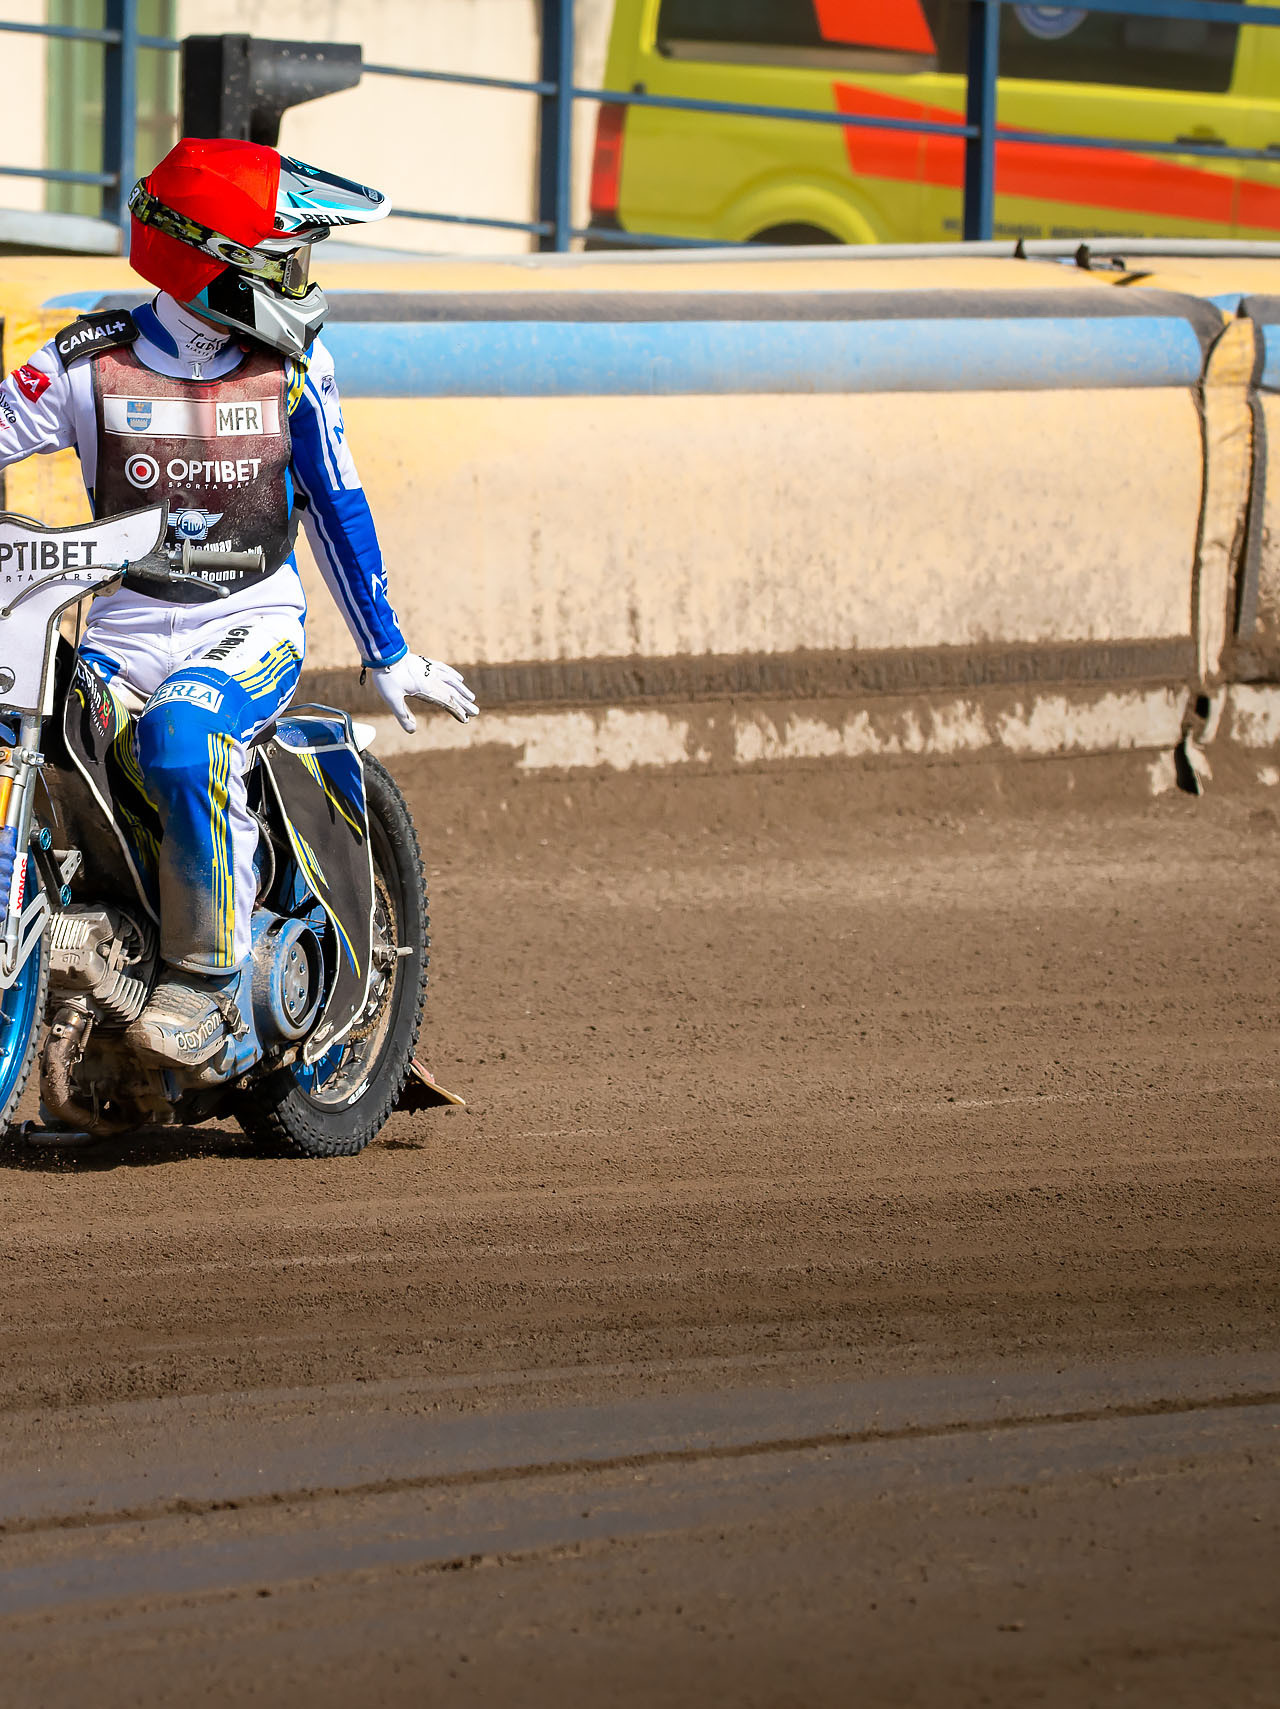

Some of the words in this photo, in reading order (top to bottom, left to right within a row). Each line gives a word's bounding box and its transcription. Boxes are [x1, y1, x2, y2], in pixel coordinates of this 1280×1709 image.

[302, 213, 350, 226] BELL
[59, 321, 126, 354] CANAL+
[218, 407, 258, 431] MFR
[166, 458, 261, 483] OPTIBET
[168, 482, 218, 490] SPORTA
[182, 520, 202, 532] FIM
[174, 1012, 223, 1050] dayton
